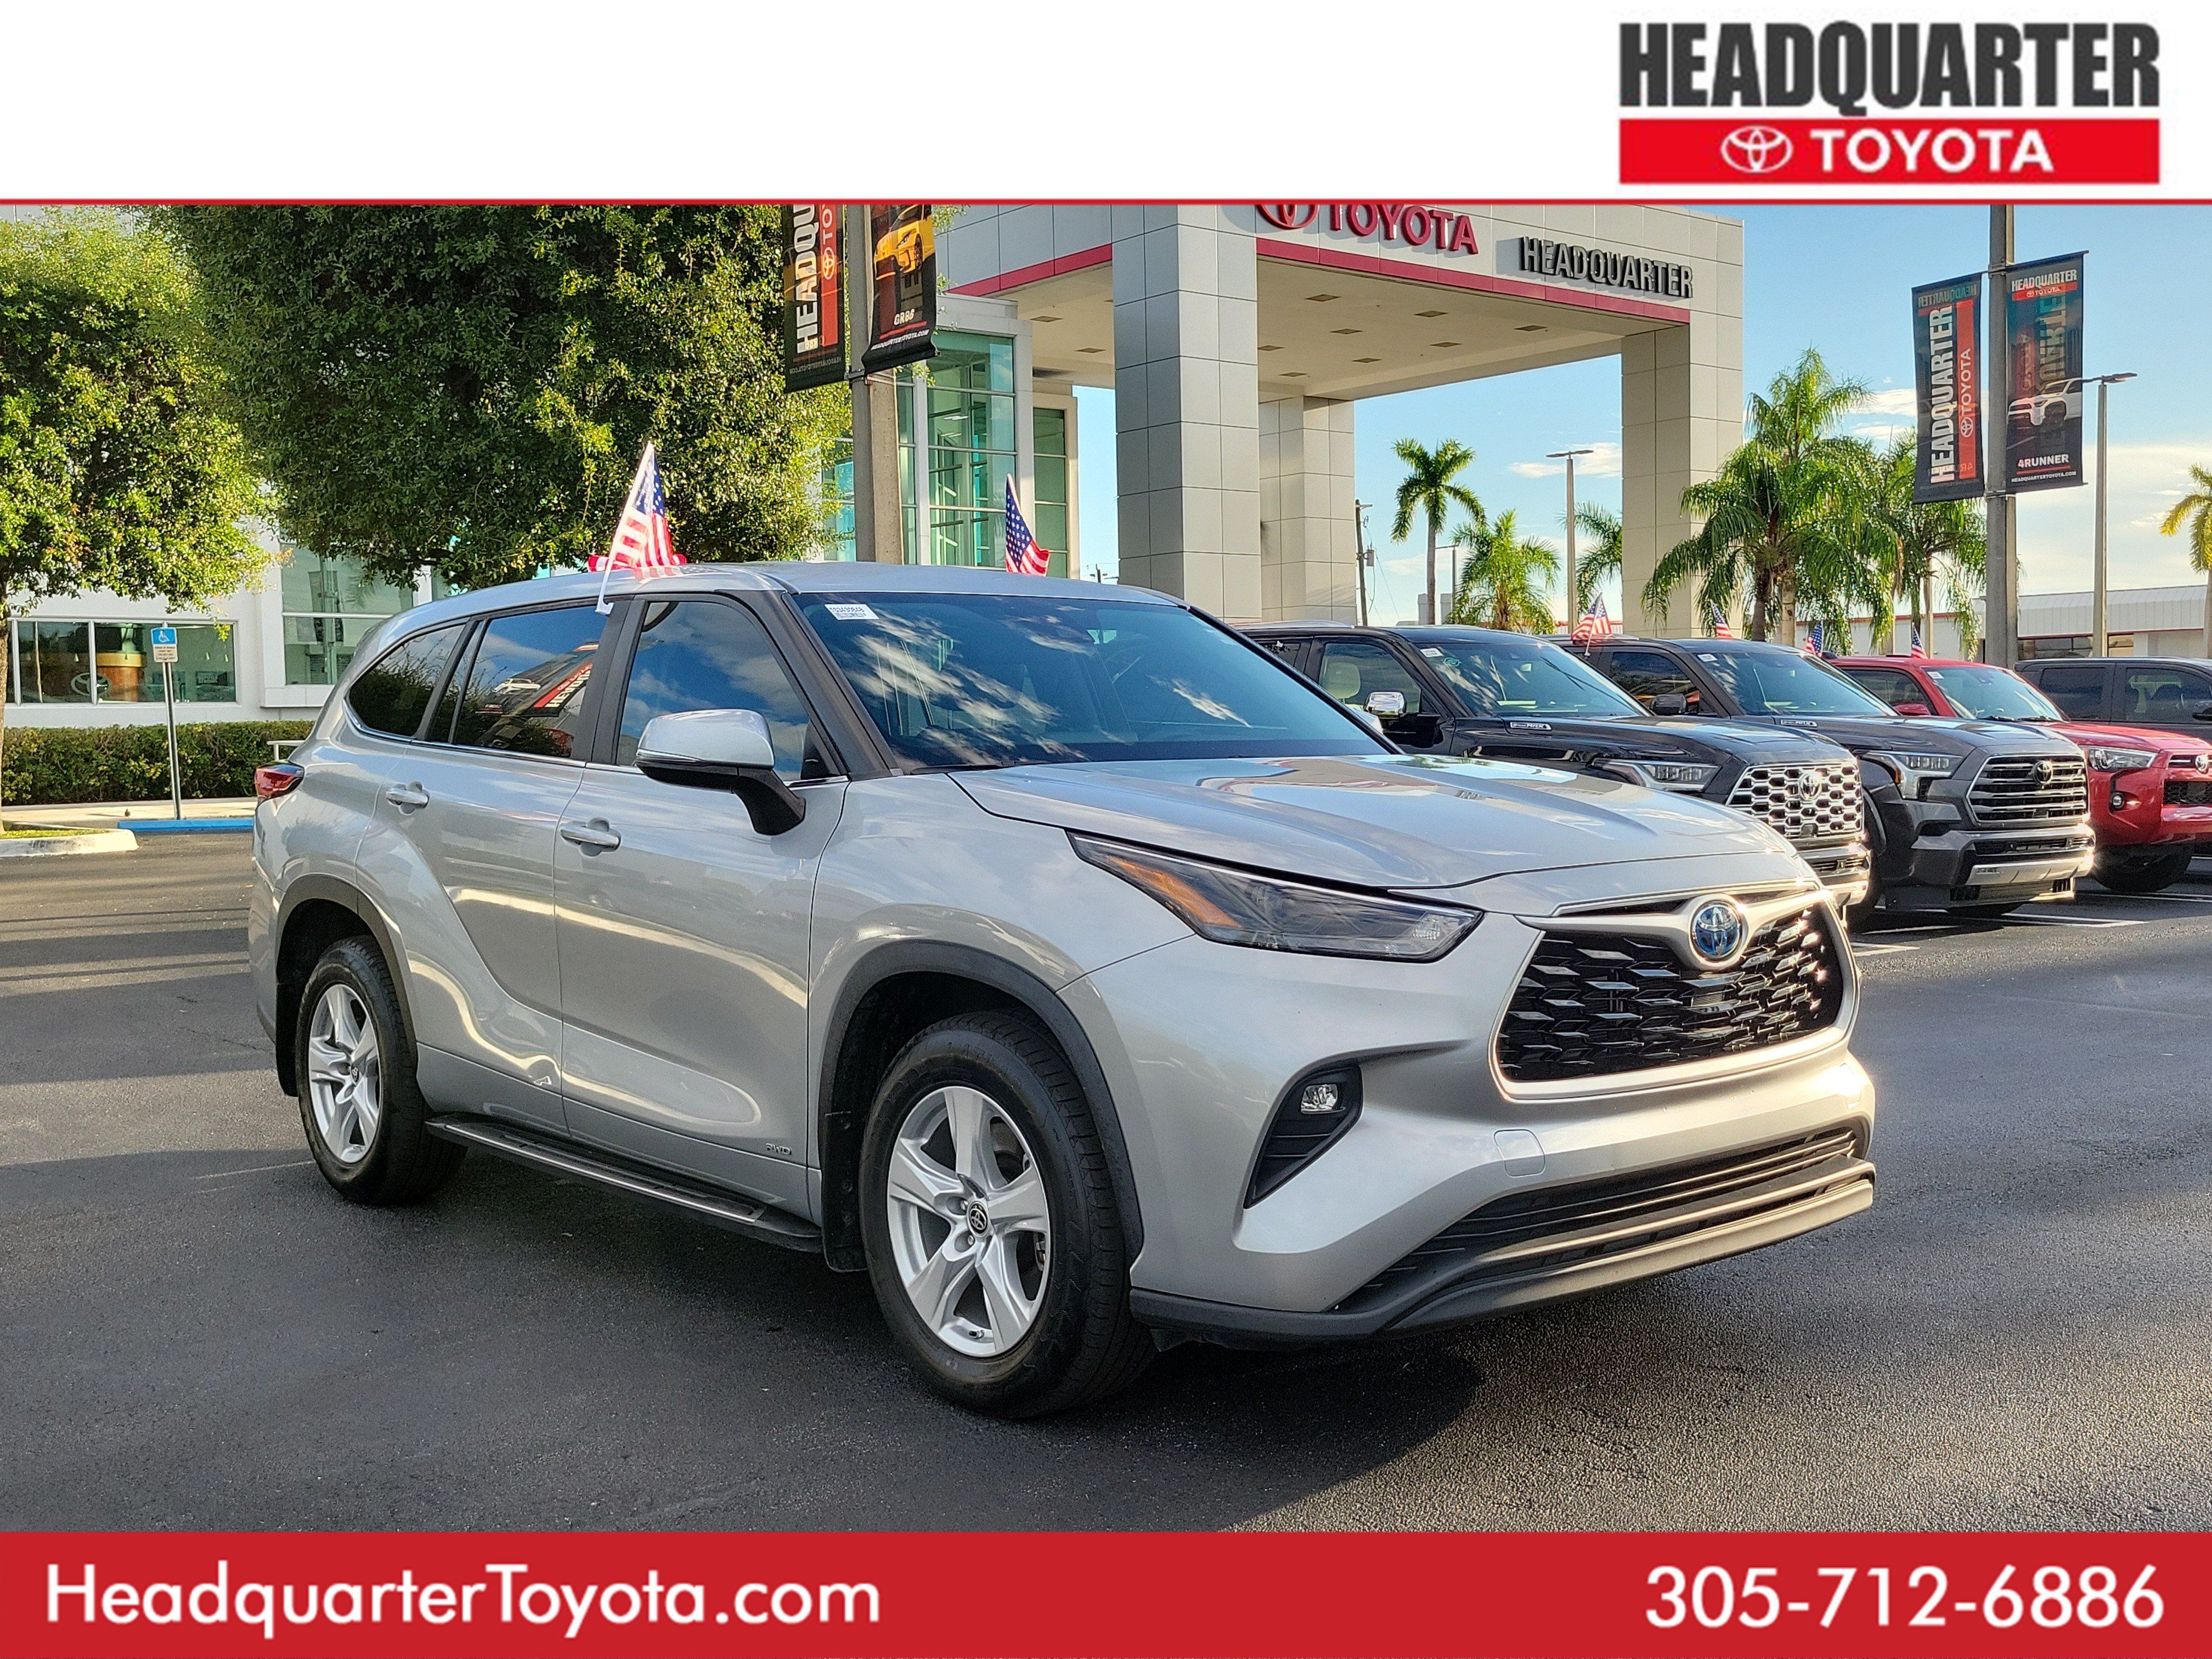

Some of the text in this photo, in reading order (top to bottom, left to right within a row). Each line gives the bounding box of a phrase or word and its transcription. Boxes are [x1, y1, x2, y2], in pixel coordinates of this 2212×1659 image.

[1521, 236, 1693, 298] HEADQUARTER
[2011, 269, 2077, 292] HEADQUARTER
[2035, 286, 2061, 296] TOYOTA
[893, 308, 916, 326] GR86
[1961, 348, 1973, 416] TOYOTA
[1929, 304, 1957, 483] HEADQUARTER
[2017, 454, 2069, 469] 4RUNNER
[2011, 471, 2077, 483] HEADQUARTERTOYOTA.COM
